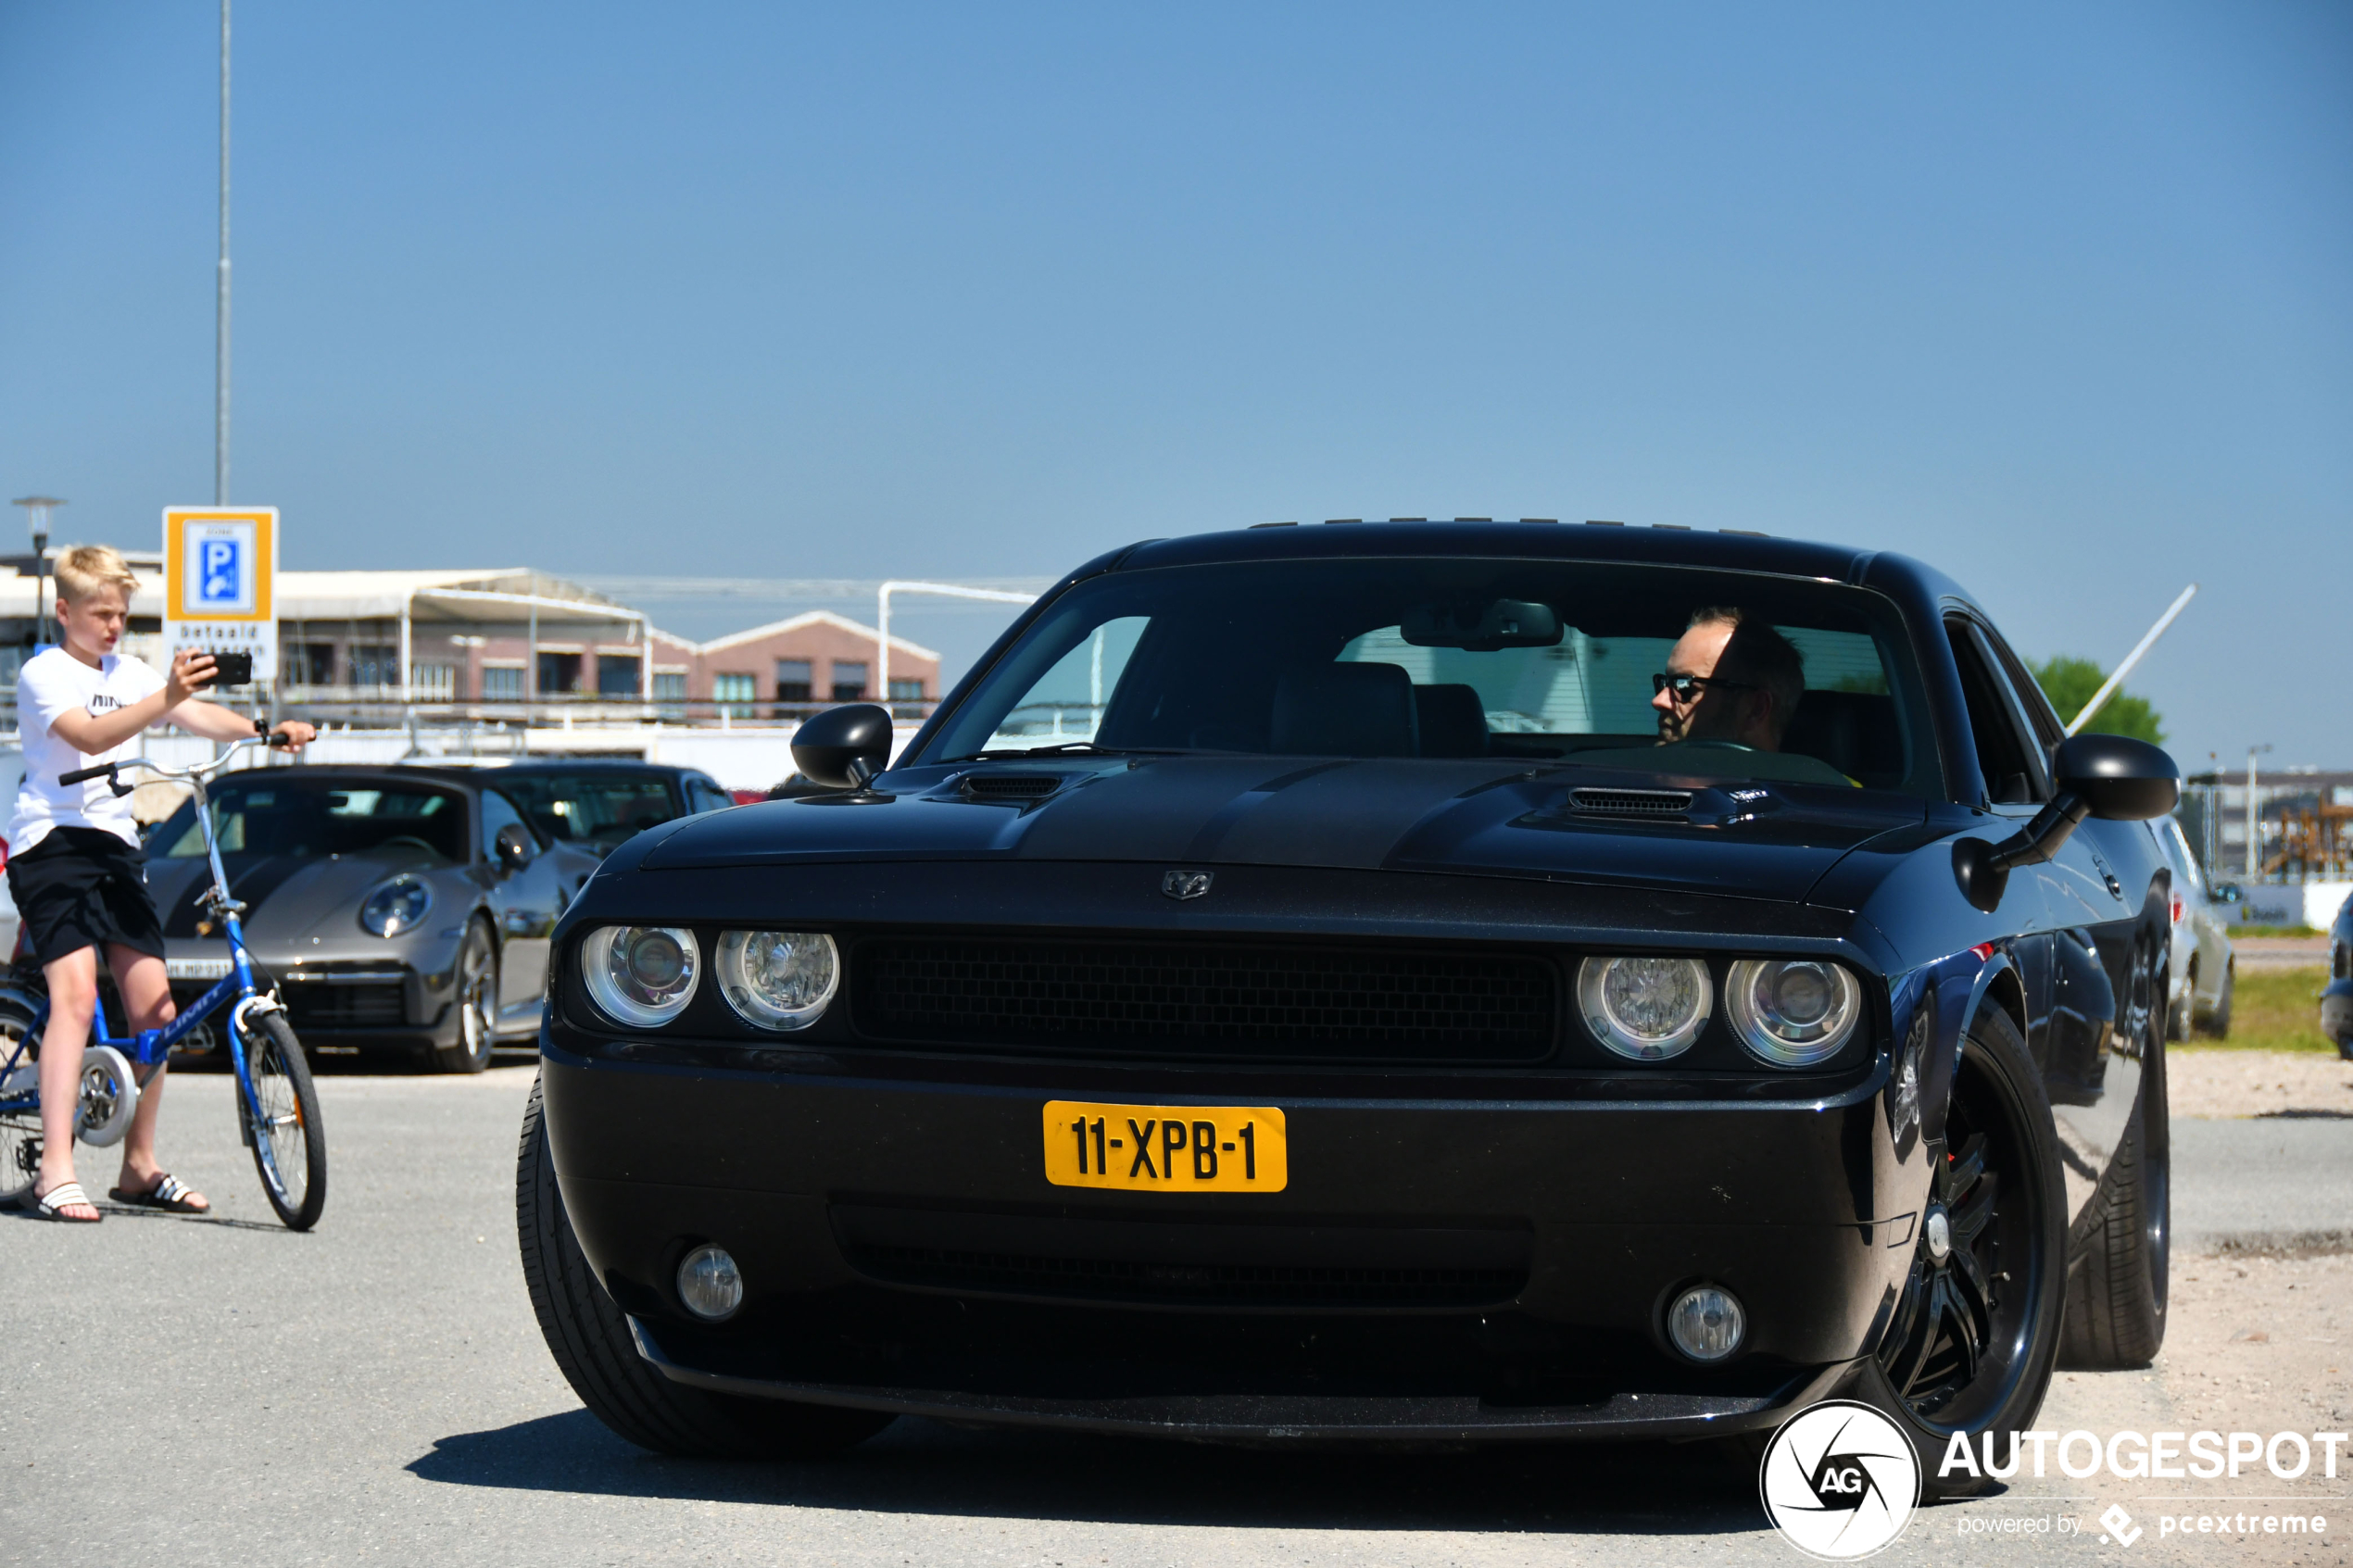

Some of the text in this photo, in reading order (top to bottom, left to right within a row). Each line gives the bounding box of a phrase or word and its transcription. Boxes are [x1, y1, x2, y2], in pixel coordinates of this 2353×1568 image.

[208, 543, 233, 577] P
[181, 623, 258, 639] betaald
[173, 641, 265, 656] prkeren
[164, 984, 222, 1038] LIMIT
[1071, 1115, 1255, 1180] 11-XPB-1
